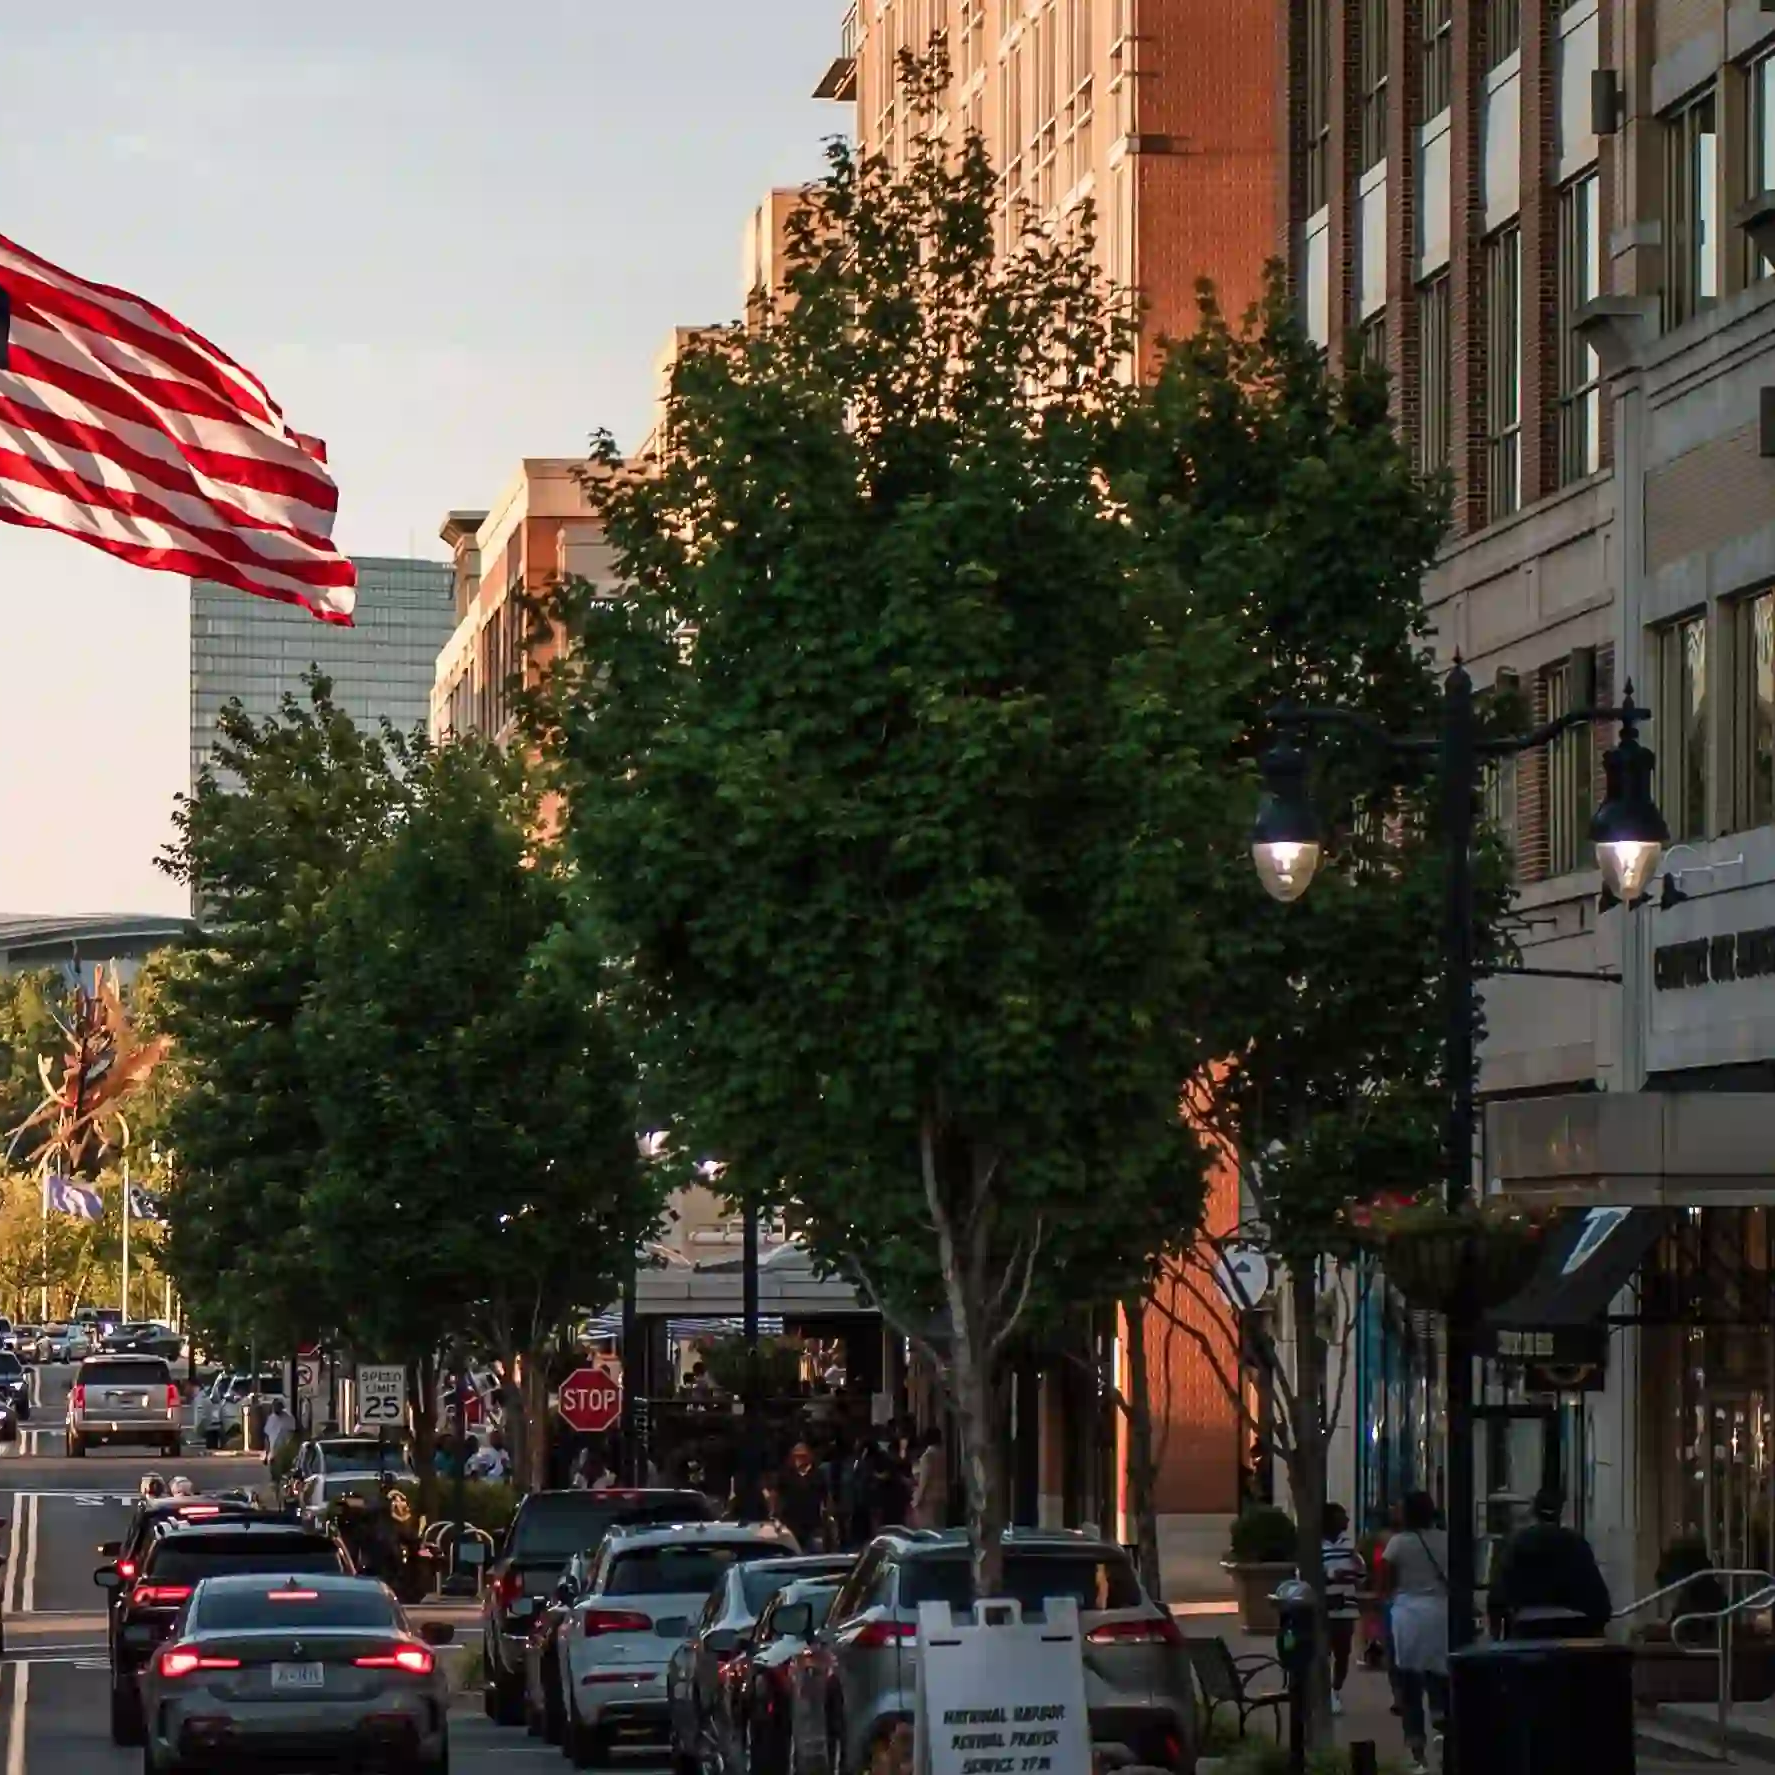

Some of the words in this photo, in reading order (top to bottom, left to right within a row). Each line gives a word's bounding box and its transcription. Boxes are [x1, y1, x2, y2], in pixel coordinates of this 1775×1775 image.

[361, 1371, 401, 1382] SPEED
[366, 1384, 397, 1394] LIMIT
[364, 1396, 400, 1418] 25
[564, 1389, 617, 1413] STOP
[943, 1706, 1008, 1725] NATIONAL
[1012, 1704, 1066, 1721] HARBOR
[1010, 1729, 1061, 1748] PRAYER
[961, 1757, 1015, 1775] SERVICE
